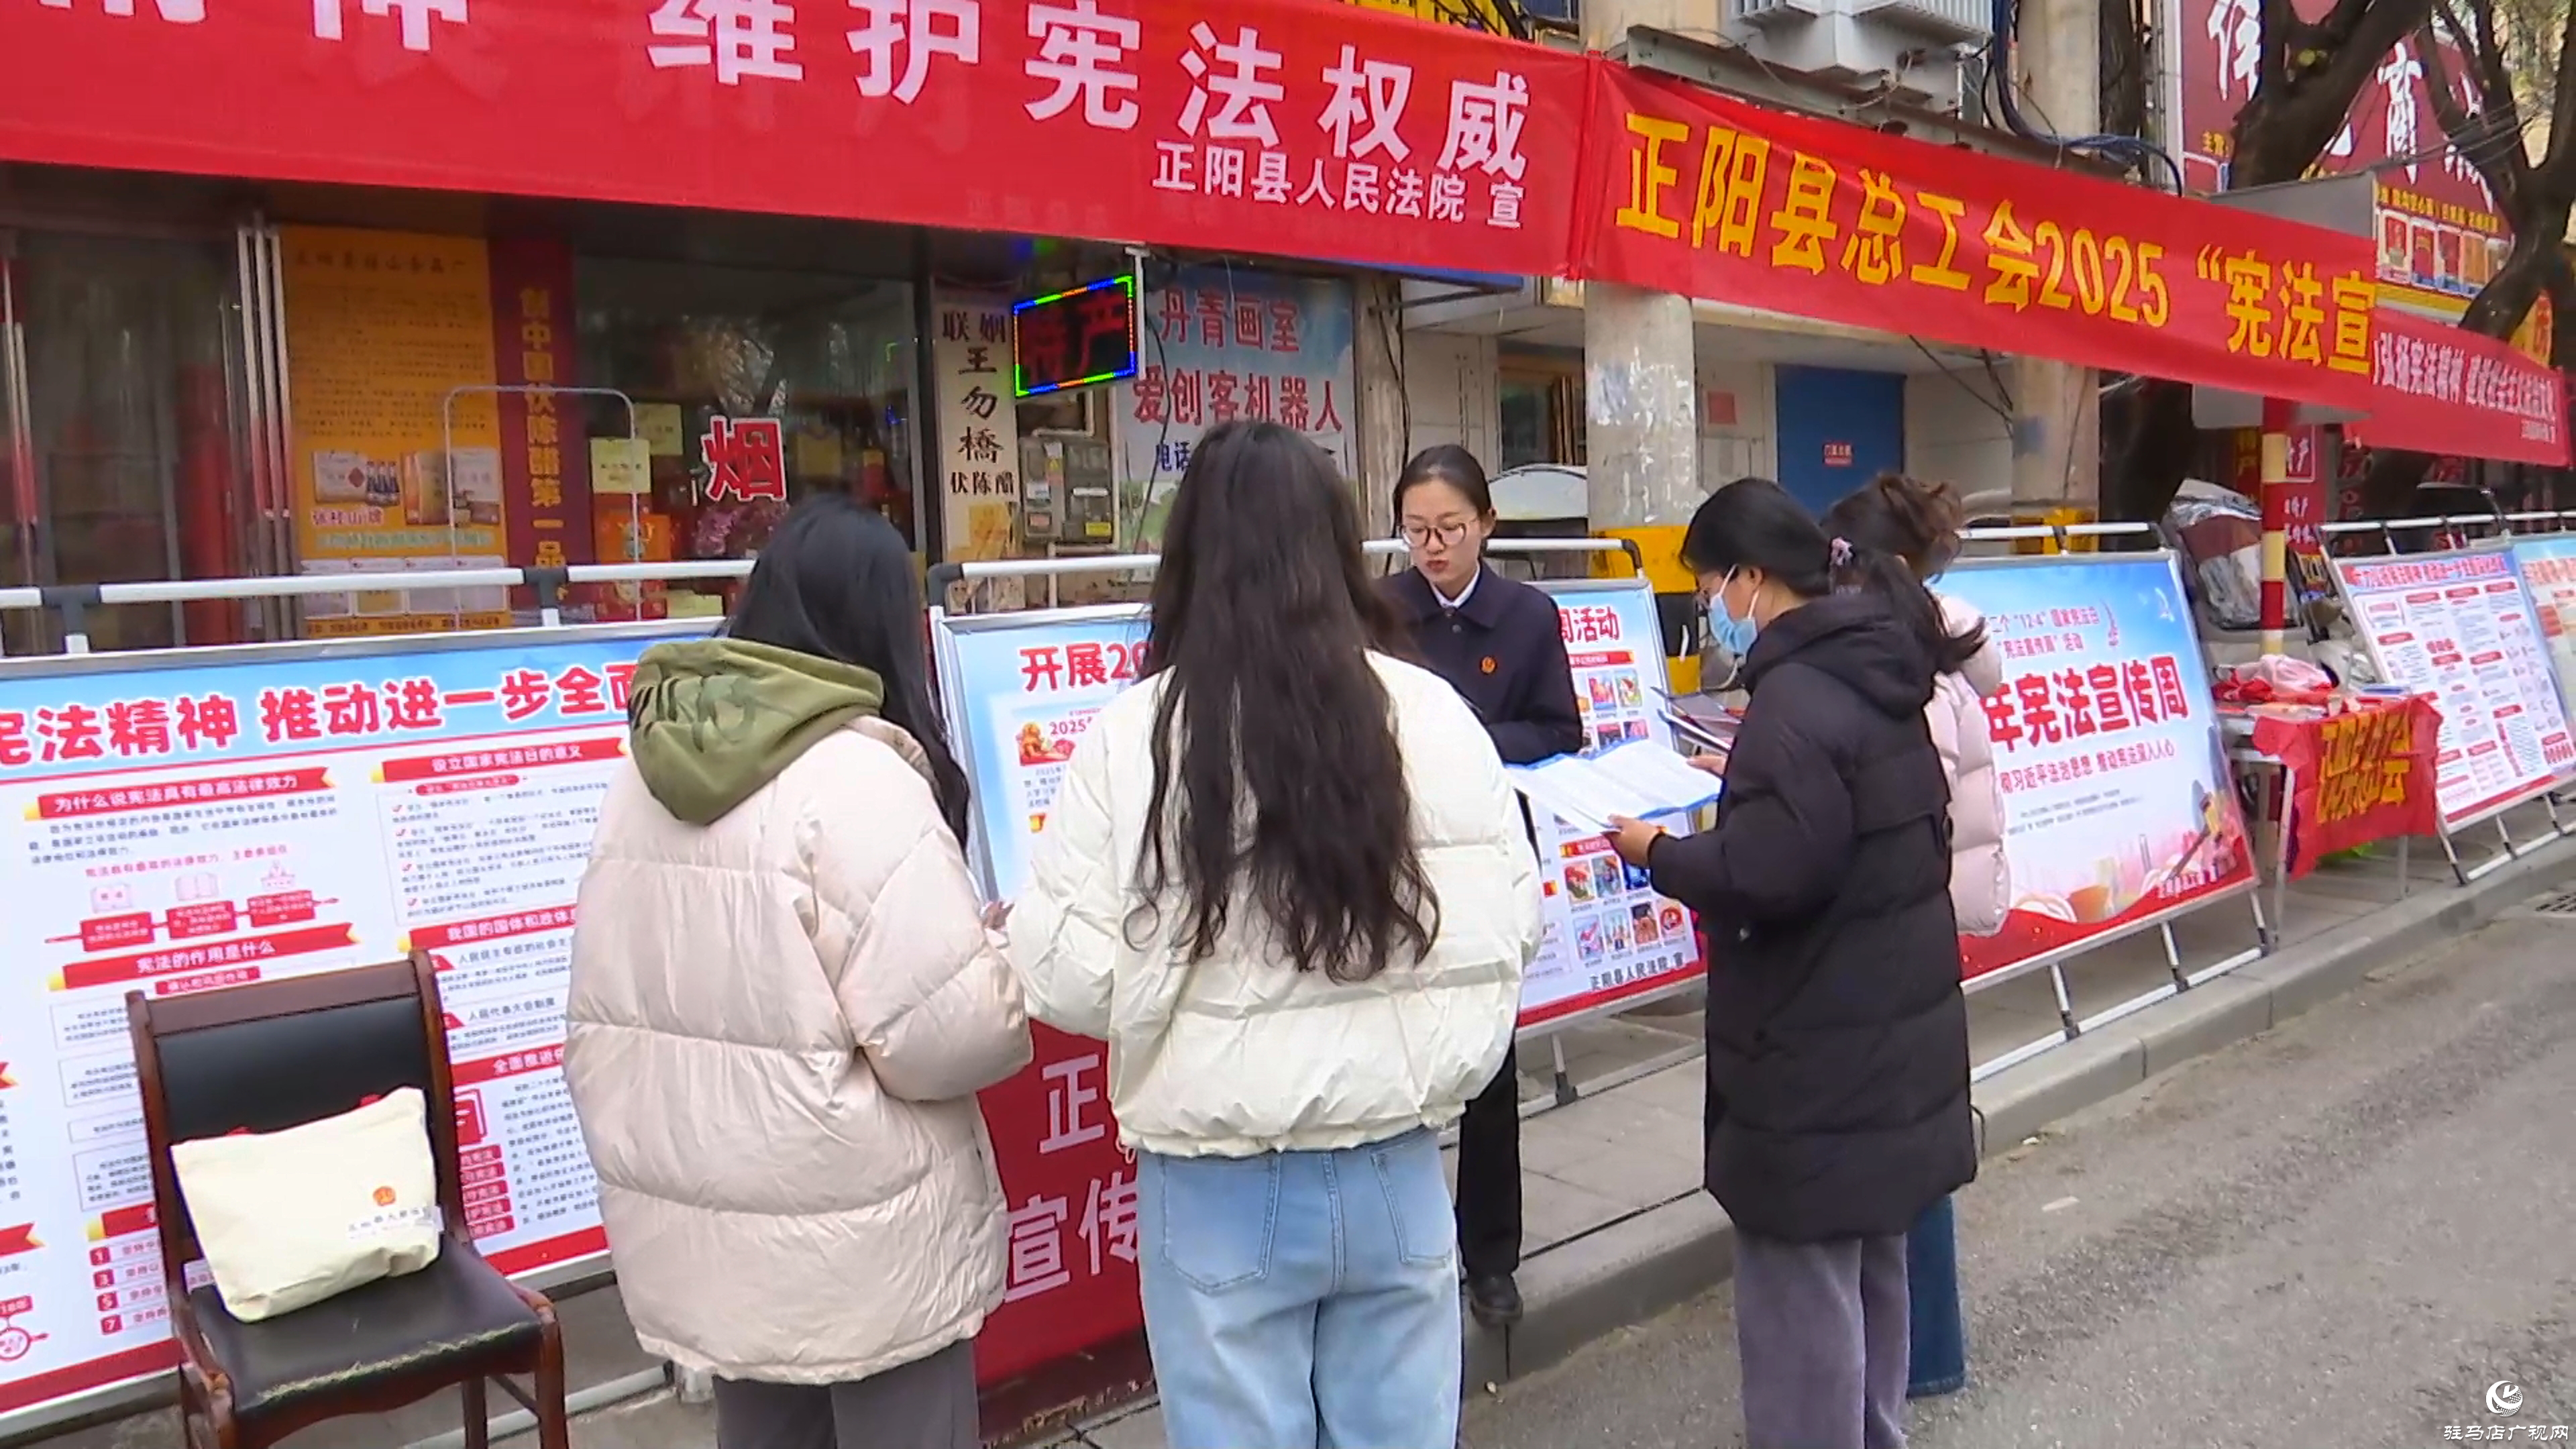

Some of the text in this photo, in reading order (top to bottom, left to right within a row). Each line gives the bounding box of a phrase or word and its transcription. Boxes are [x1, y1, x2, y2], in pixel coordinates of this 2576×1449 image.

[647, 0, 1529, 181] 维护宪法权威
[1152, 140, 1524, 229] 正阳县人民法院 宣
[1158, 288, 1300, 353] 丹青画室
[1132, 366, 1342, 434] 爱创客机器人
[700, 415, 787, 502] 烟
[1980, 655, 2189, 753] 年宪法宣传周
[54, 775, 297, 812] 为什么说宪法具有最高法律效力
[137, 939, 276, 974] 宪法的作用是什么
[447, 907, 576, 942] 我国的国体和政体
[1040, 1053, 1105, 1154] 正
